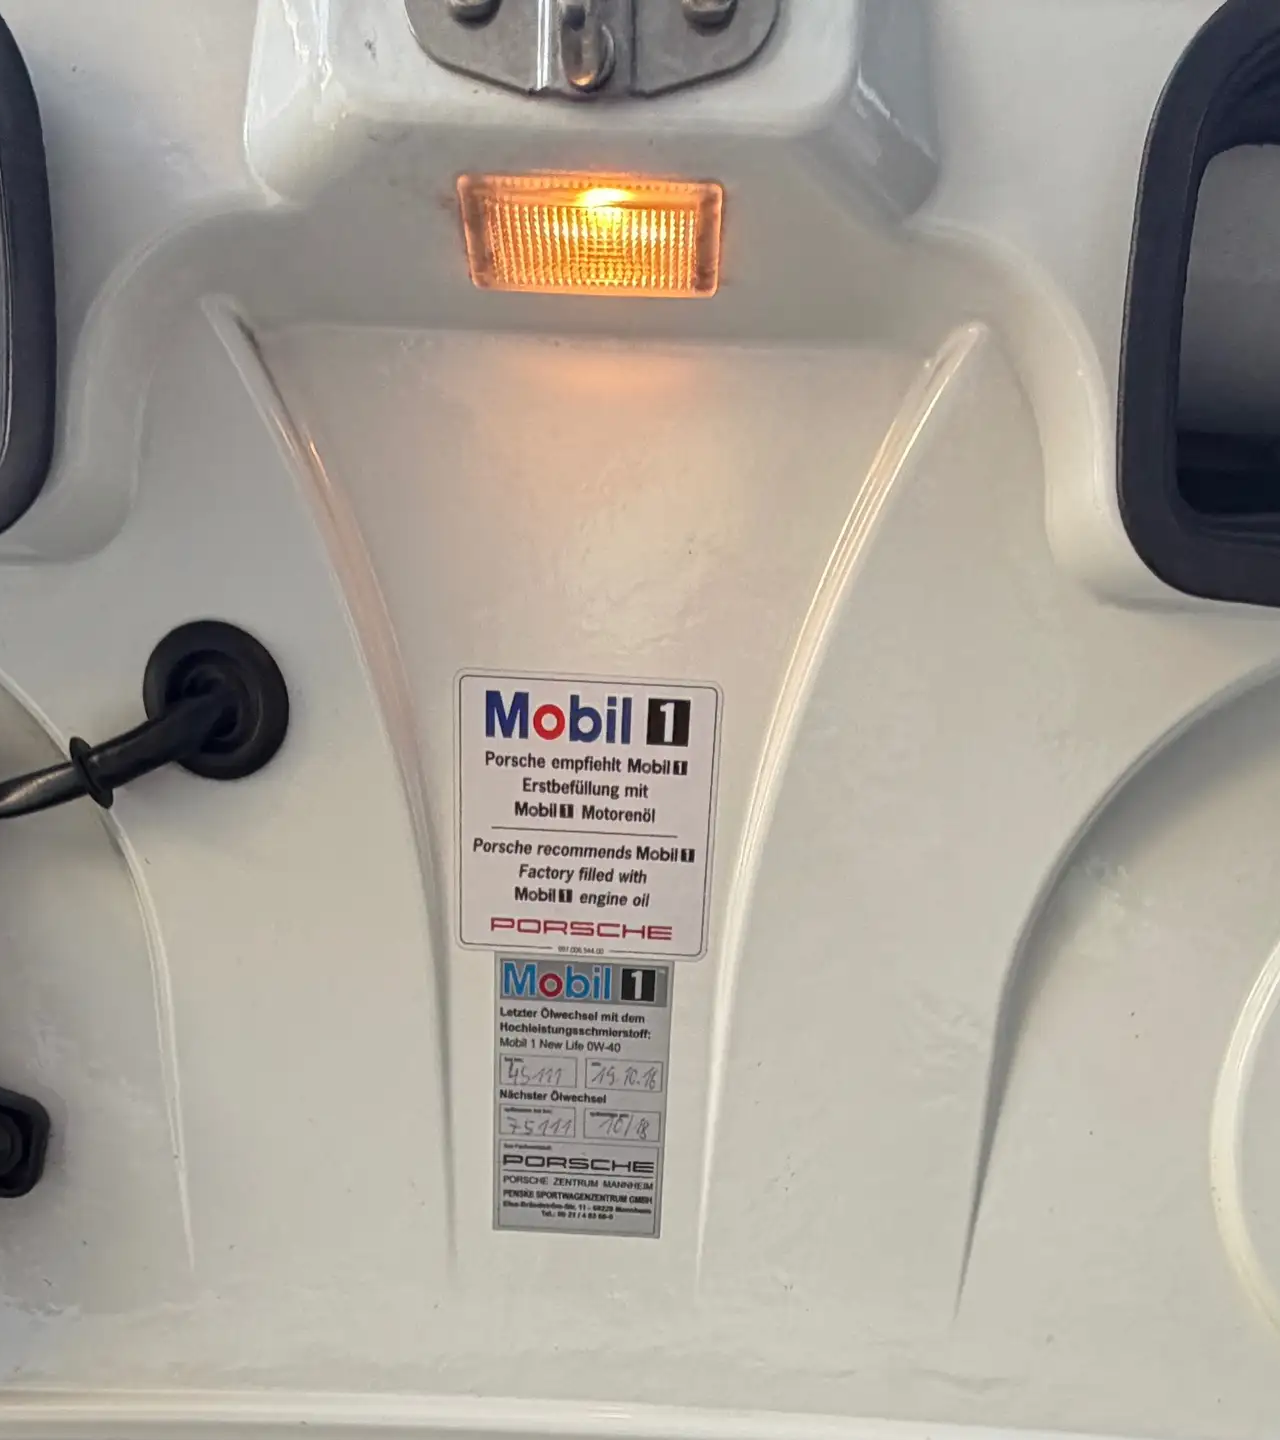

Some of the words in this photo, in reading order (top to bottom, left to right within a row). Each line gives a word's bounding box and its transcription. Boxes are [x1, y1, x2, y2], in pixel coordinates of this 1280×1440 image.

[485, 690, 632, 744] Mobil
[485, 751, 546, 769] Porsche
[551, 753, 622, 774] empfiehlt
[522, 777, 620, 800] Erstbefüllung
[624, 783, 648, 798] mit
[581, 804, 655, 823] Motorenöl
[473, 837, 532, 855] Porsche
[536, 843, 632, 860] recommends
[519, 864, 574, 883] Factory
[578, 866, 614, 883] filled
[618, 869, 647, 884] with
[579, 892, 628, 908] engine
[632, 893, 650, 907] oil
[490, 917, 673, 941] PORSCHE
[503, 960, 612, 1000] Mobil
[500, 1007, 537, 1018] Letzter
[540, 1007, 598, 1021] Ölwechsel
[601, 1011, 618, 1022] mit
[621, 1011, 645, 1023] dem
[500, 1022, 651, 1039] Hochleistungsschmierstoff:
[500, 1037, 527, 1048] Mobil
[531, 1039, 535, 1048] 1
[539, 1040, 563, 1049] New
[566, 1040, 584, 1050] Life
[499, 1088, 548, 1101] Nächster
[550, 1089, 607, 1104] Ölwechsel
[503, 1154, 654, 1173] PORSCHE
[503, 1175, 548, 1186] PORSCHE
[553, 1177, 599, 1188] ZENTRUM
[603, 1180, 653, 1190] MANNHEIM
[503, 1189, 534, 1198] PENSKE
